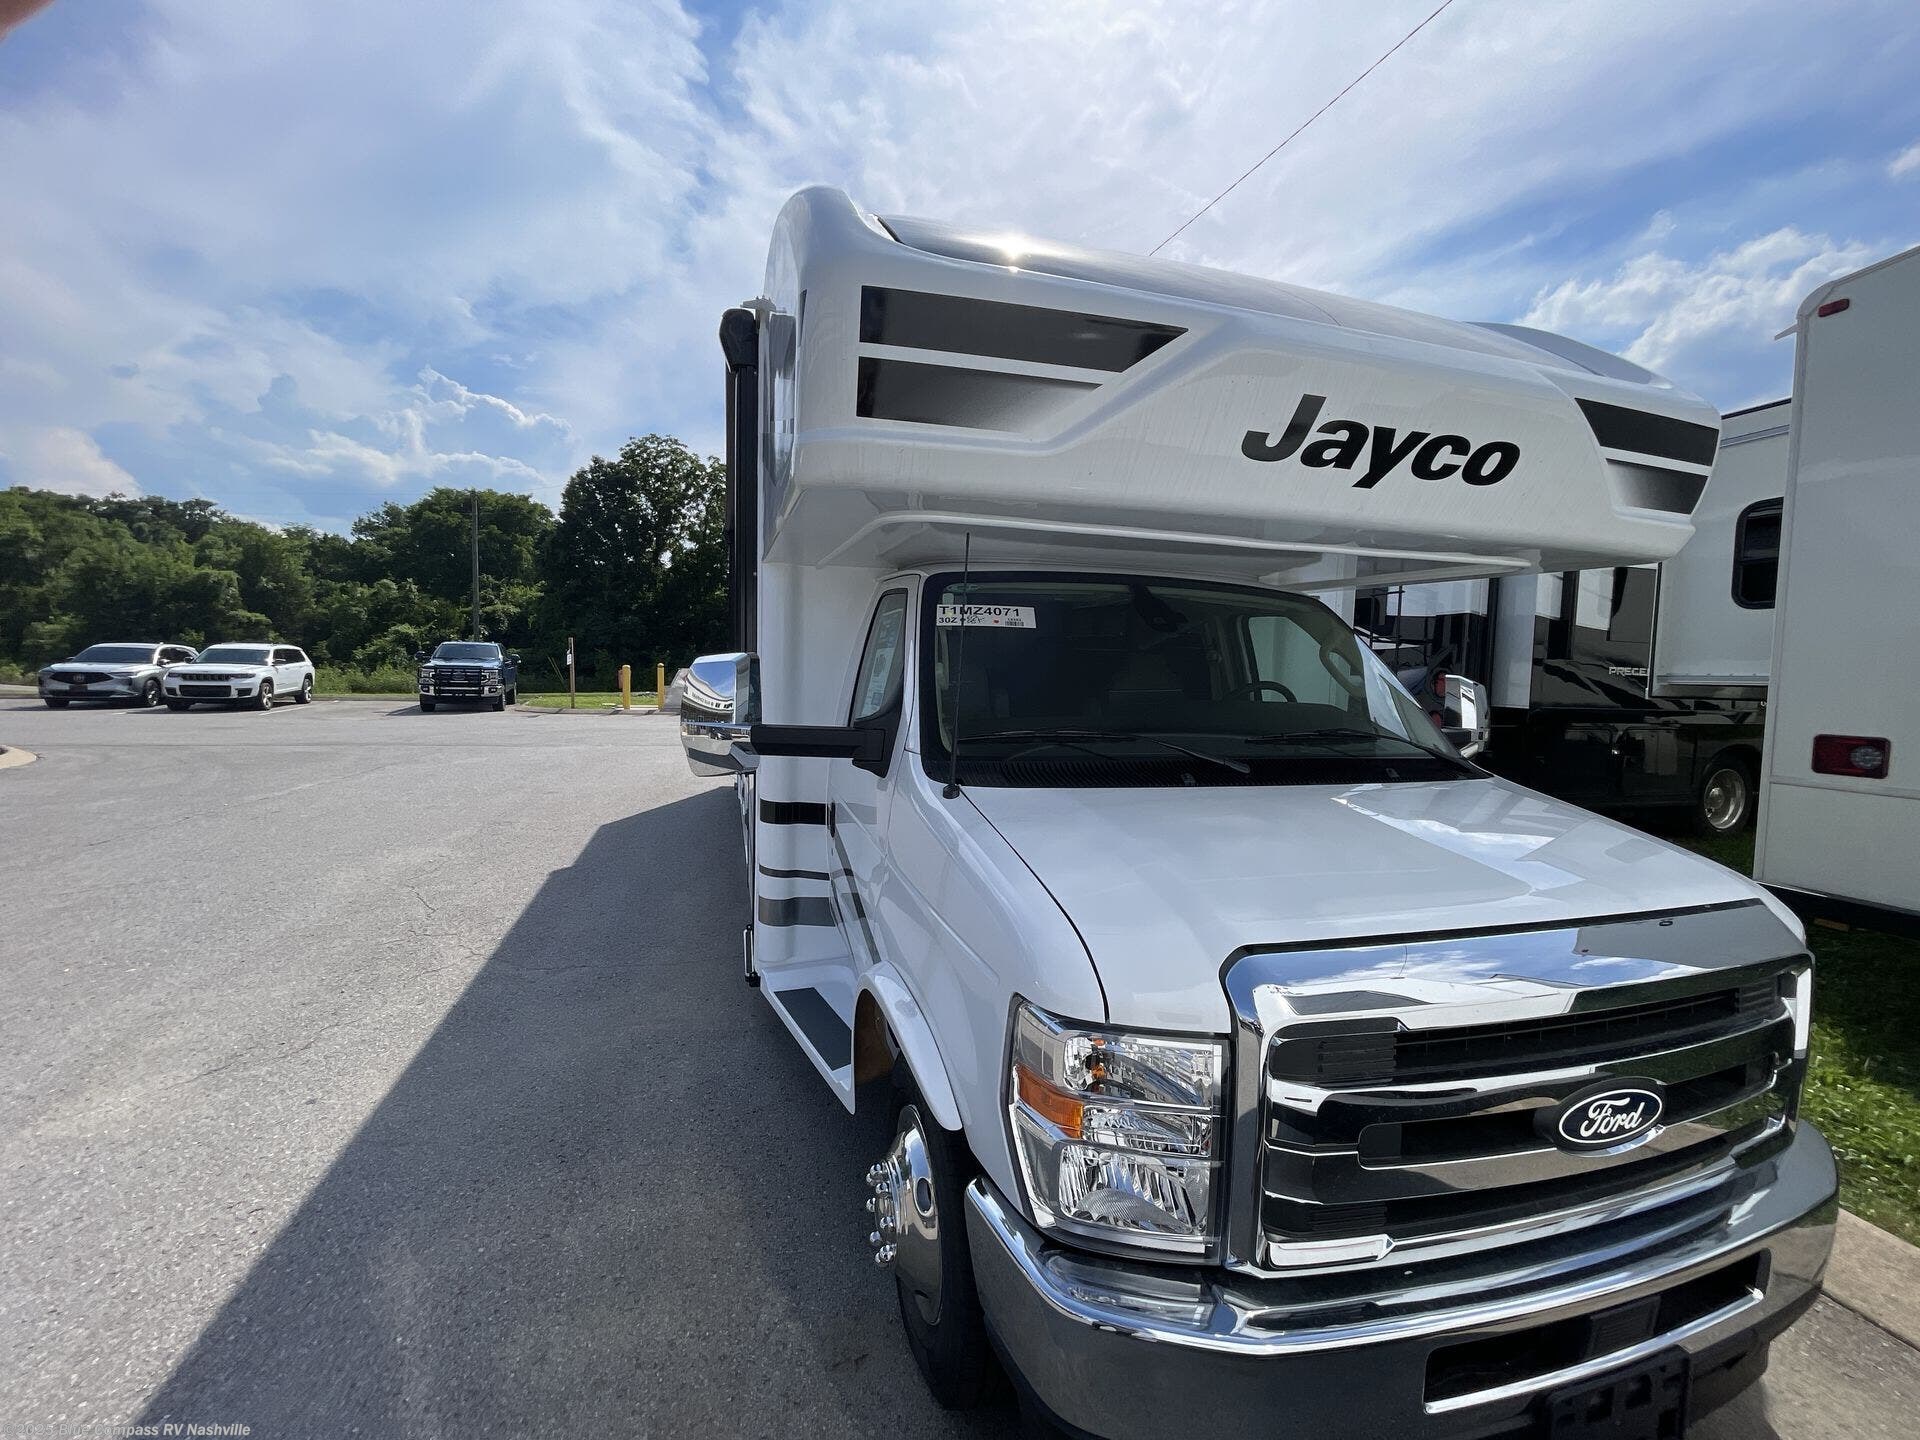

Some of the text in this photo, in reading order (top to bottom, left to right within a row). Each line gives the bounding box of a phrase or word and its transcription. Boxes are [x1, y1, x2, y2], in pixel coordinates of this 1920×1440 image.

[1241, 393, 1520, 489] Jayco
[939, 606, 1019, 617] T1MZ4071
[1608, 666, 1649, 677] PRECE
[1580, 1097, 1645, 1137] Ford
